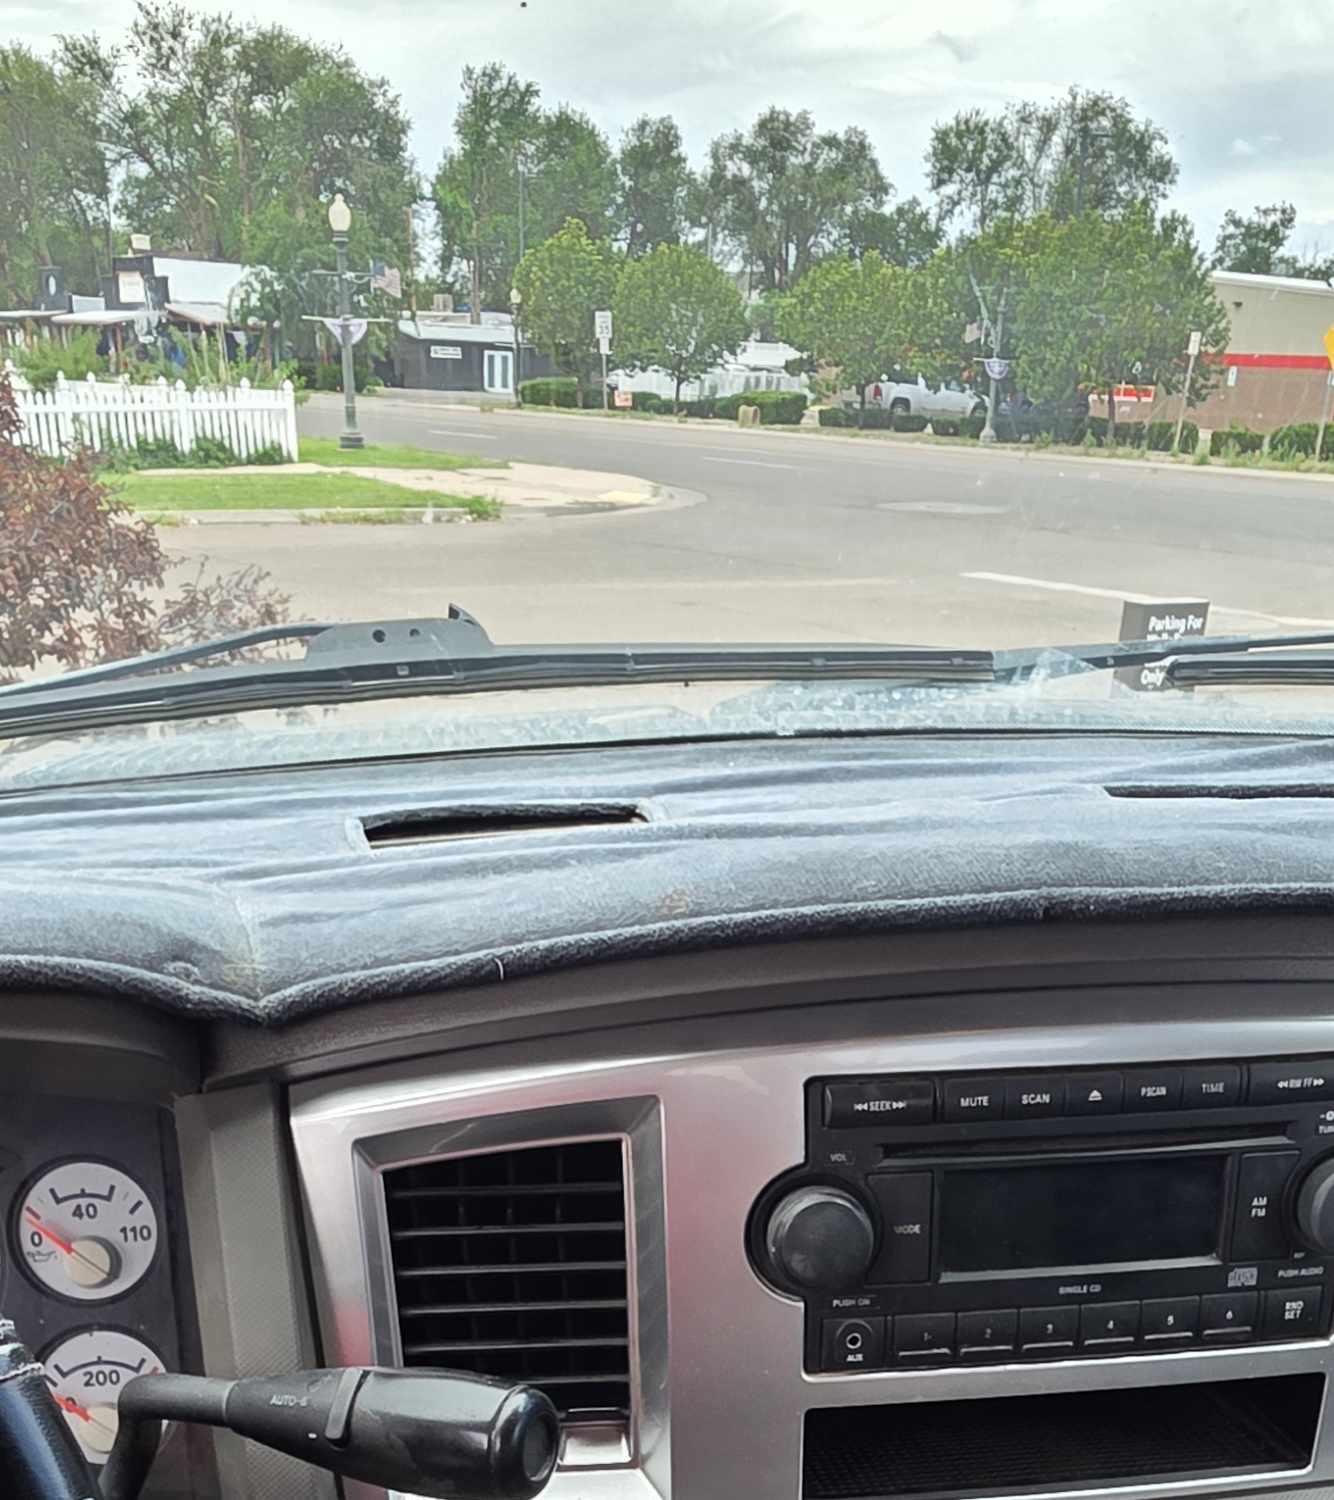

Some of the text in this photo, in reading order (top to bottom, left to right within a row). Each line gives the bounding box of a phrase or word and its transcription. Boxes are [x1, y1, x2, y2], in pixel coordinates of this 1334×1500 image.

[1148, 614, 1204, 634] Parking For
[1140, 667, 1166, 687] Only
[1141, 1086, 1166, 1097] PSCAN
[1202, 1082, 1224, 1093] TIME
[960, 1096, 989, 1107] MUTE
[1021, 1094, 1050, 1105] SCAN
[869, 1101, 892, 1111] SEEK
[830, 1153, 846, 1162] VOL
[1252, 1196, 1267, 1206] AM
[72, 1203, 98, 1220] 40
[1251, 1207, 1266, 1218] FM
[120, 1225, 152, 1243] 110
[894, 1224, 921, 1234] MODE
[30, 1231, 43, 1248] 0
[1059, 1284, 1101, 1295] SINGLE CD
[833, 1298, 870, 1307] PUSH ON
[1285, 1300, 1304, 1310] RND
[1167, 1315, 1174, 1326] 5
[1226, 1310, 1233, 1320] 6
[1284, 1310, 1301, 1320] SET
[1047, 1324, 1054, 1334] 3
[1107, 1320, 1114, 1329] 4
[984, 1328, 992, 1338] 2
[83, 1369, 121, 1387] 200
